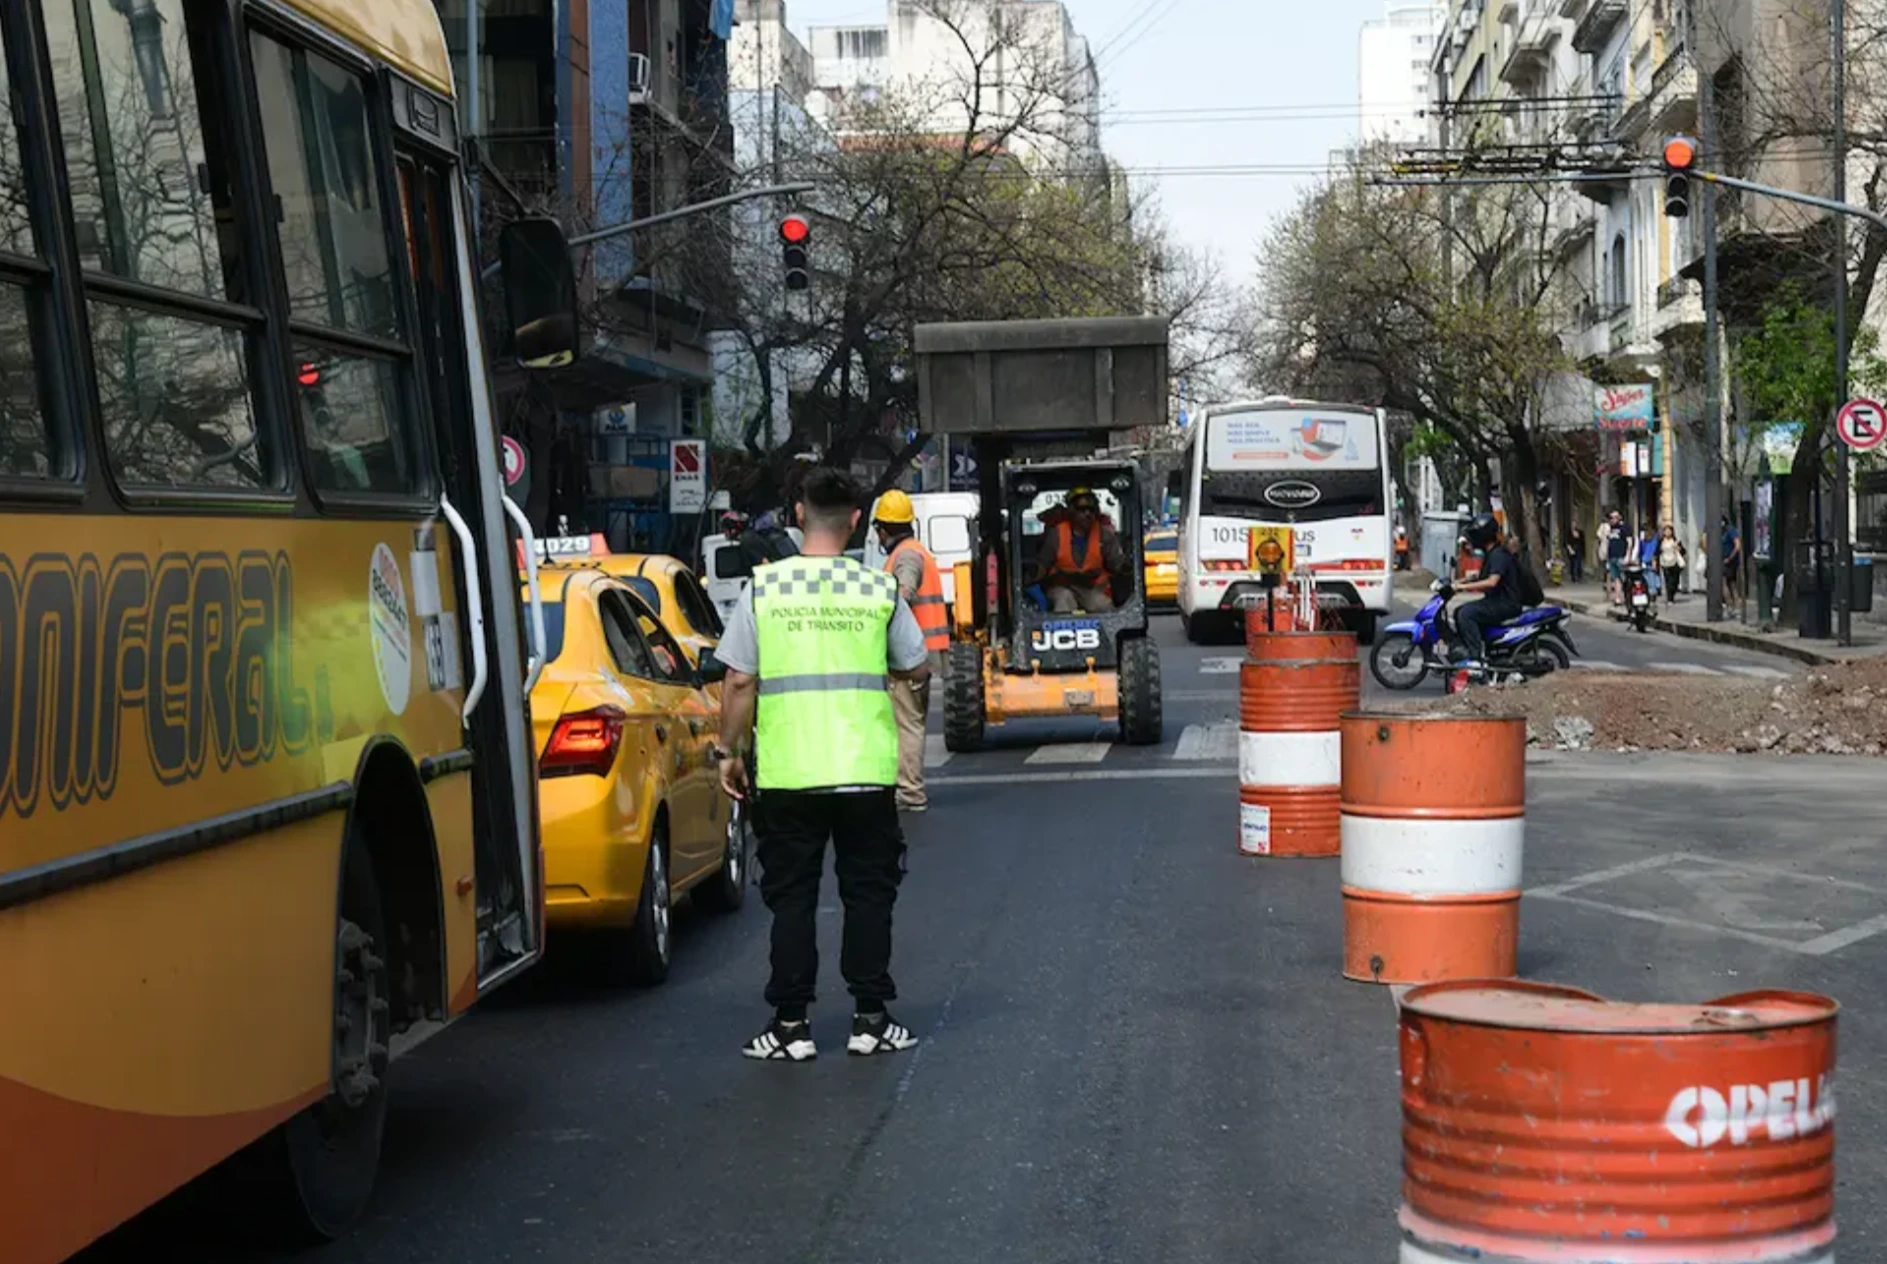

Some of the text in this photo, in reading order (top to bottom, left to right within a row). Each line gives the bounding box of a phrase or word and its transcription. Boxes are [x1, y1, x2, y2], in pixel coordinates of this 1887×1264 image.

[1853, 409, 1874, 437] E
[819, 606, 880, 620] MUNICIPAL
[787, 620, 802, 632] DE
[1031, 629, 1100, 651] JCB
